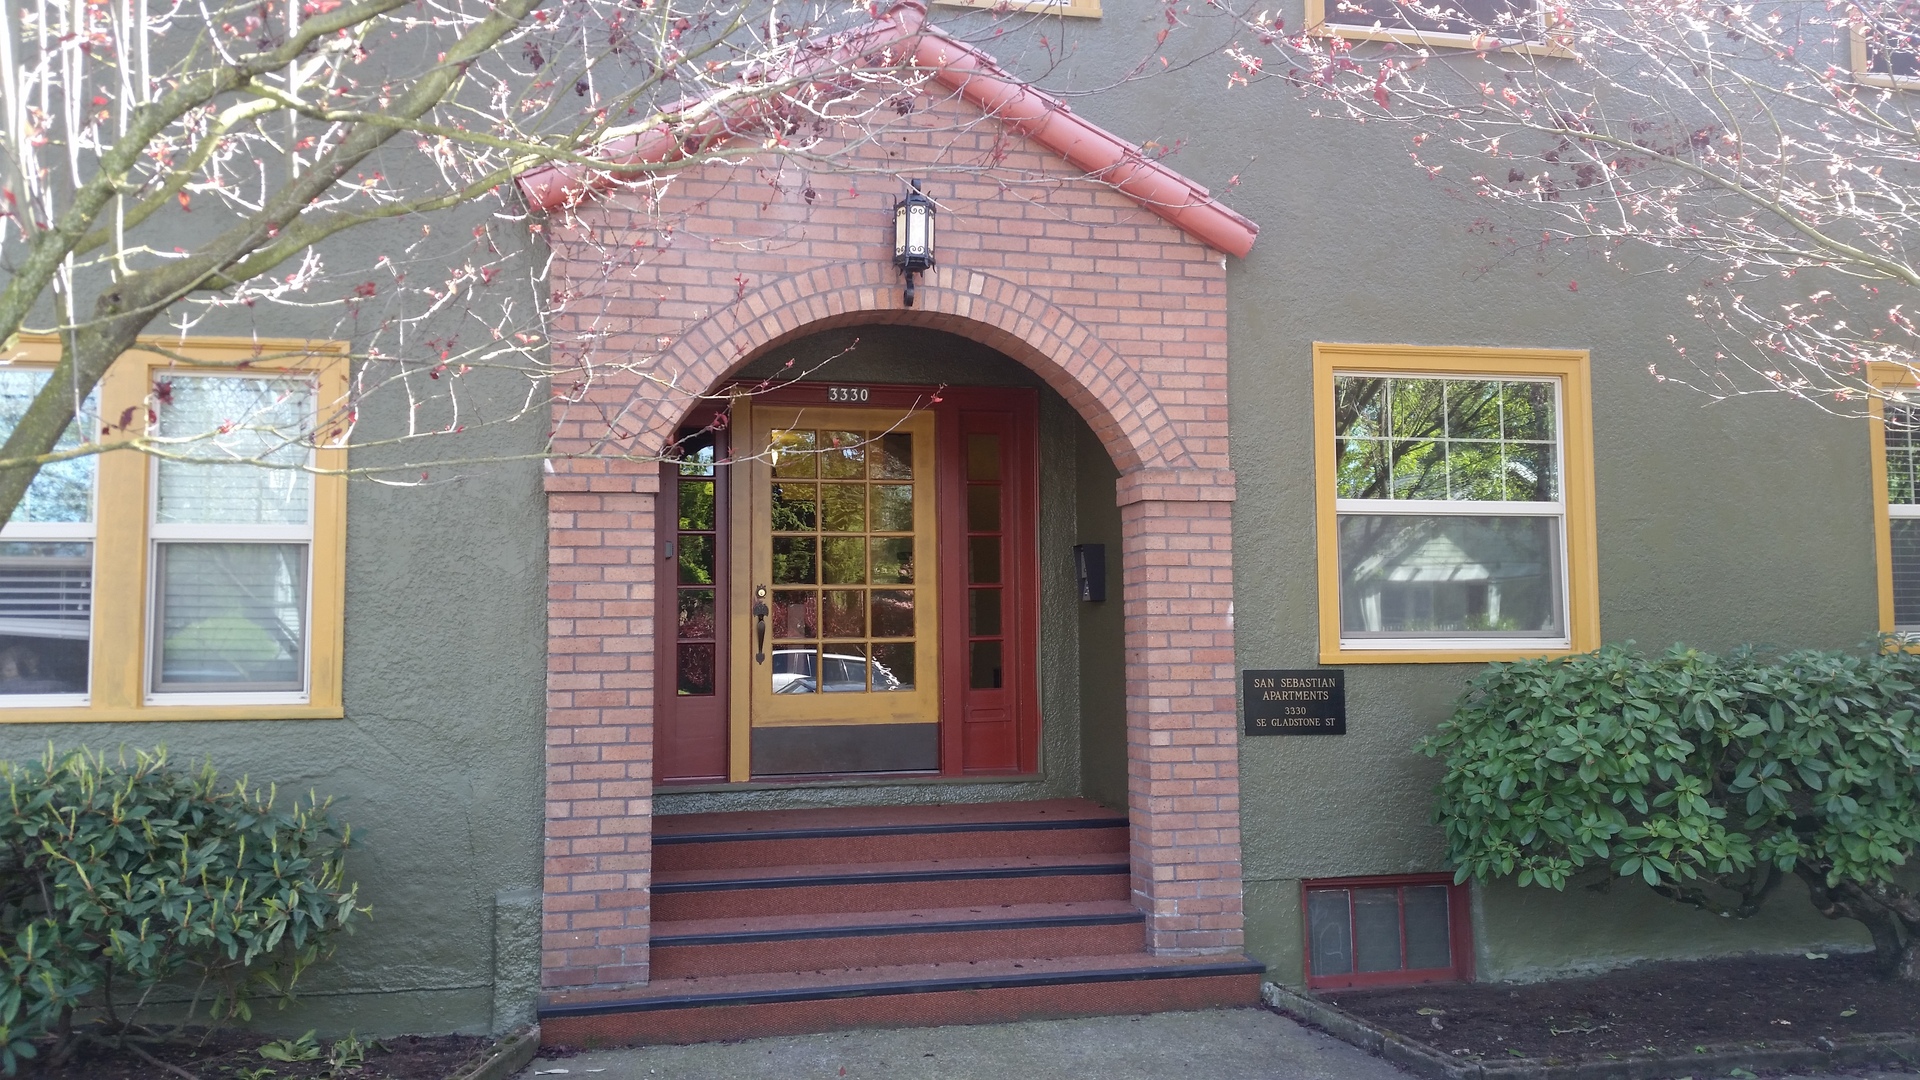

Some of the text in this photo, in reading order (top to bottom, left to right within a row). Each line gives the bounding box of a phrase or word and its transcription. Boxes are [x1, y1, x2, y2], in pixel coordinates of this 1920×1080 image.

[829, 387, 868, 401] 3330
[1254, 678, 1336, 688] SAN SEBASTIAN
[1262, 690, 1329, 700] APARTMENTS
[1284, 706, 1307, 715] 3330
[1256, 717, 1336, 727] SE GLADSTONE ST
